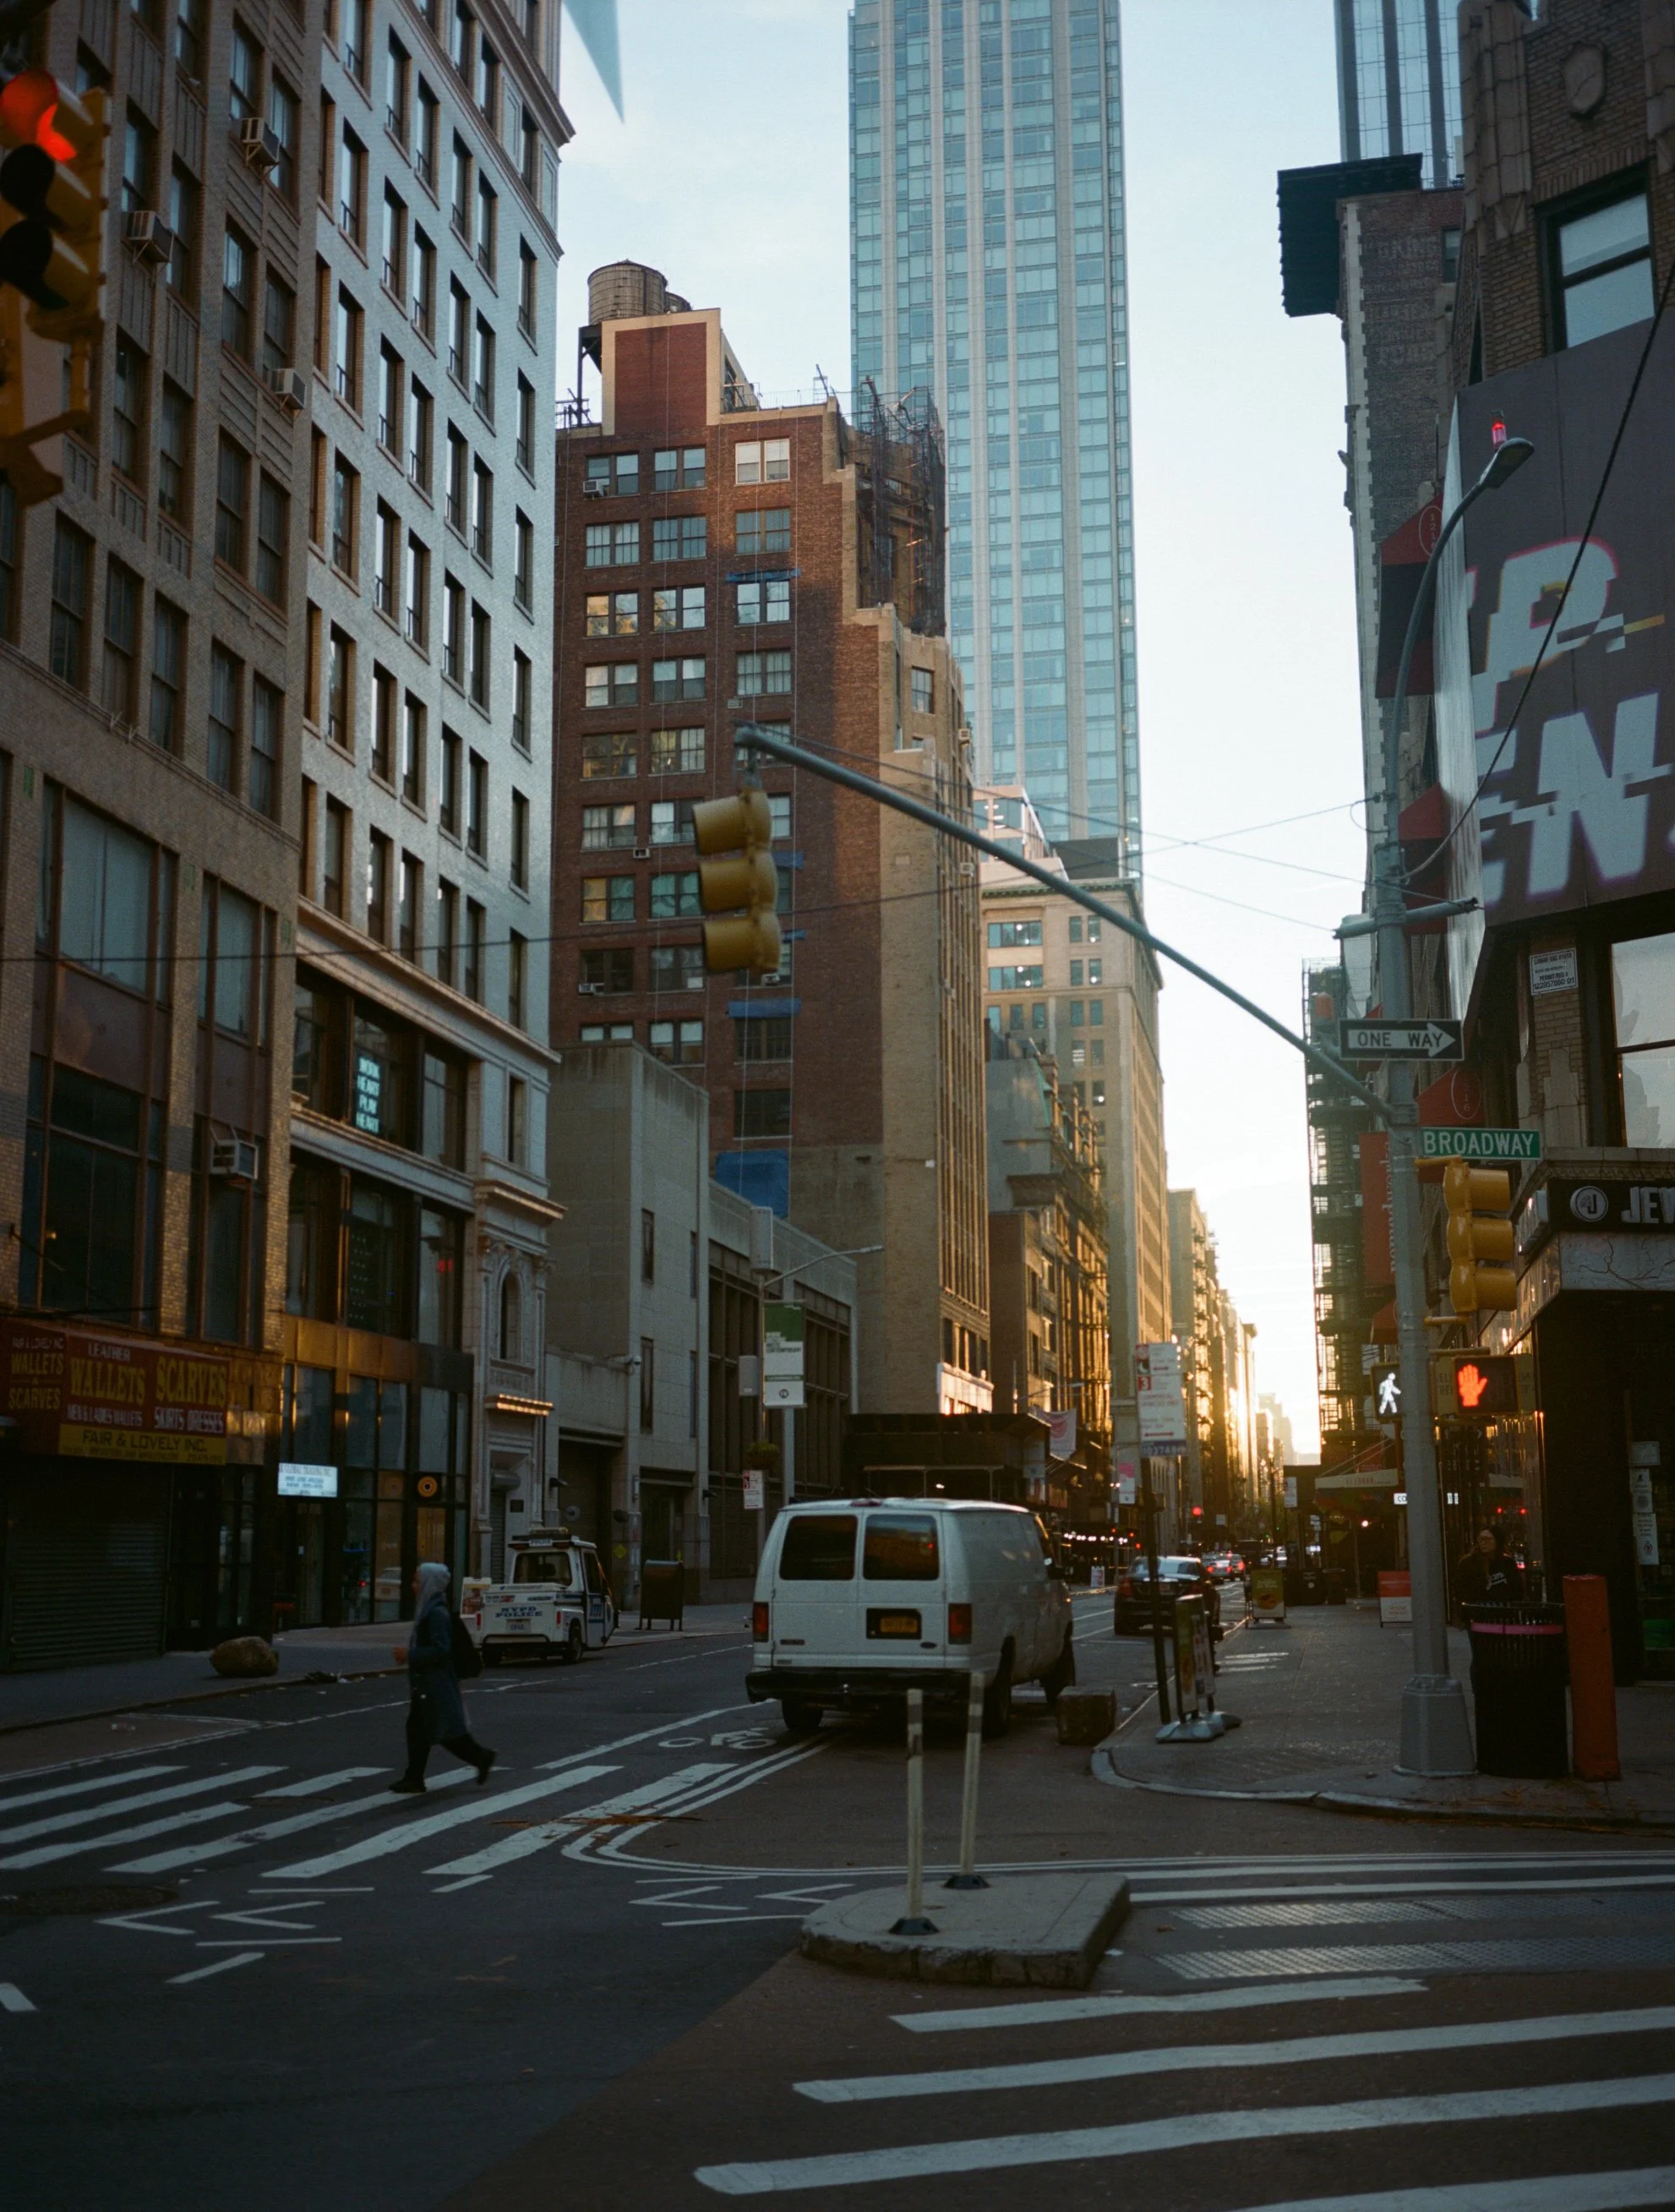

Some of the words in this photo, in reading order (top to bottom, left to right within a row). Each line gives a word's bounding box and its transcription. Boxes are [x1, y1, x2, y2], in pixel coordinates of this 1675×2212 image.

[1357, 1031, 1392, 1047] ONE
[1407, 1031, 1443, 1047] WAY
[1422, 1131, 1534, 1156] BROADWAY
[11, 1352, 64, 1375] WALLETS
[88, 1341, 131, 1363] LEATHER
[70, 1357, 146, 1406] WALLETS
[155, 1355, 227, 1409] SCARVES
[8, 1387, 62, 1411] SCARVES
[188, 1409, 224, 1434] DRESSES
[83, 1429, 112, 1446] FAIR
[117, 1433, 127, 1447] &
[130, 1435, 180, 1450] LOVELY
